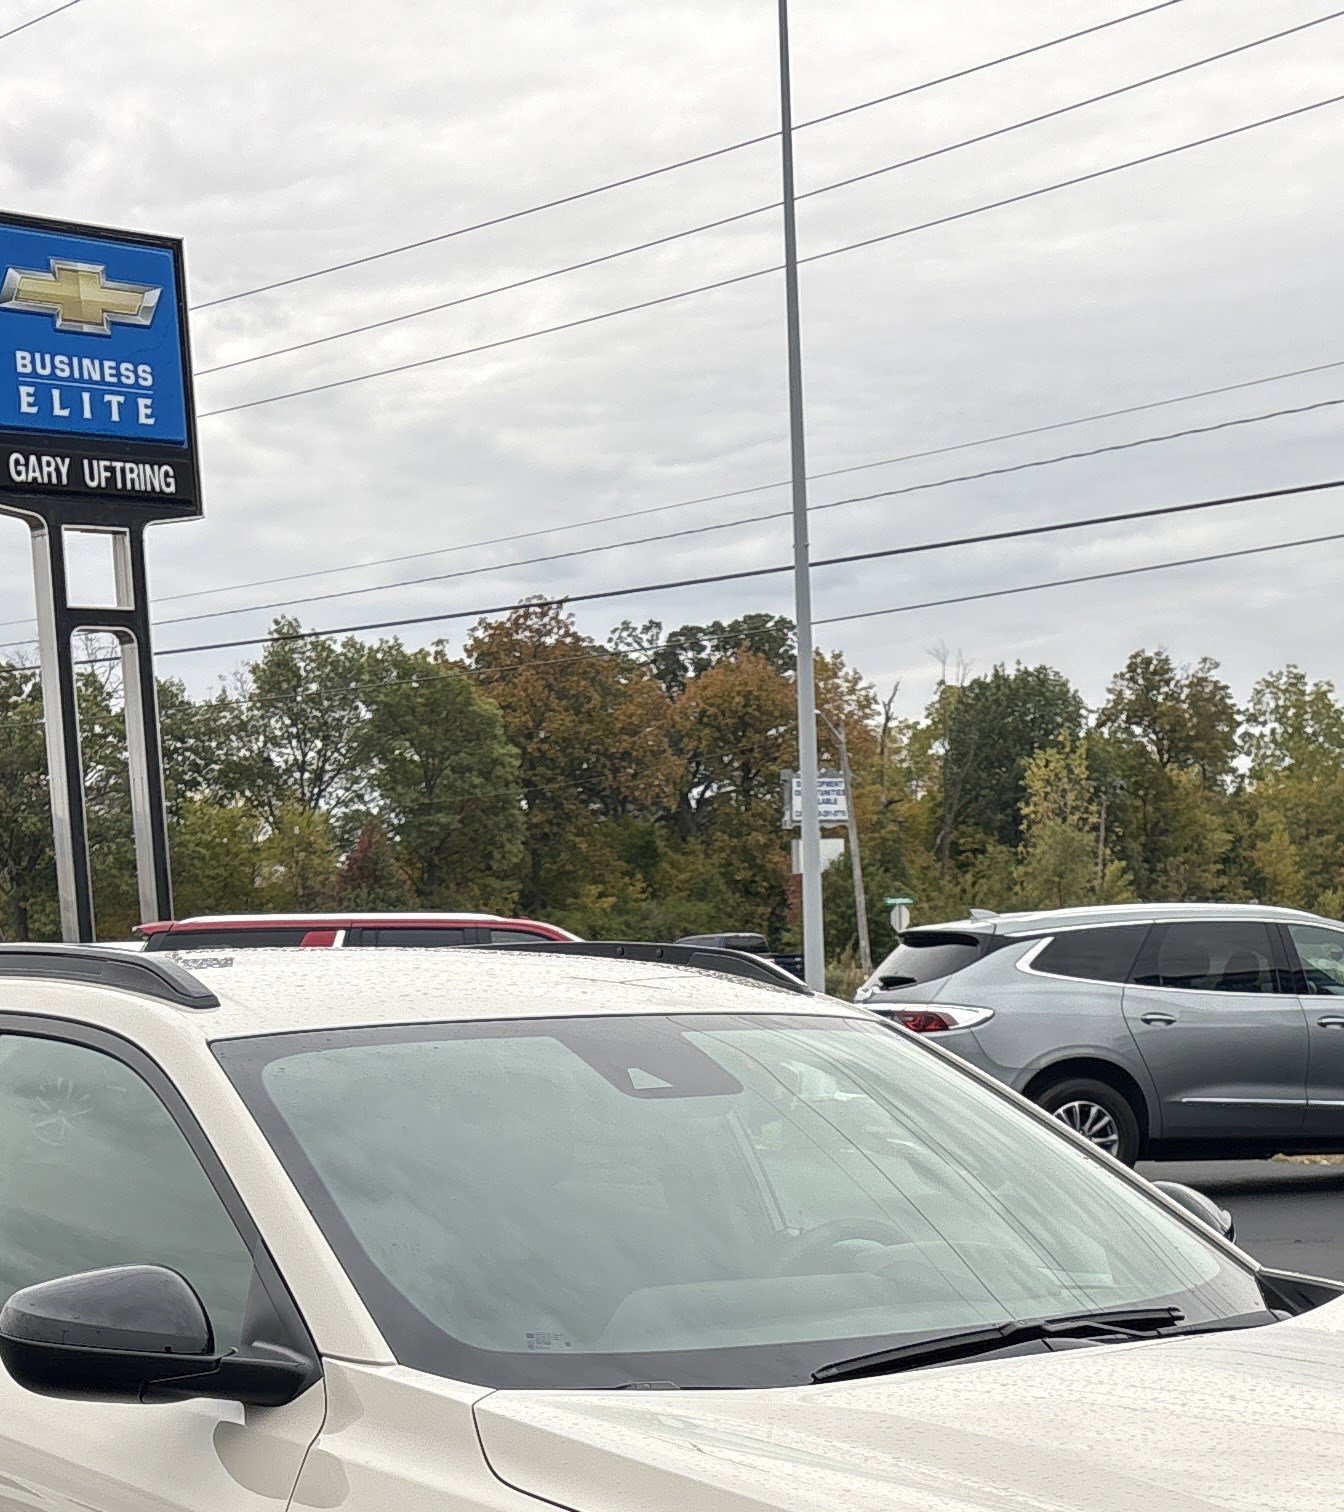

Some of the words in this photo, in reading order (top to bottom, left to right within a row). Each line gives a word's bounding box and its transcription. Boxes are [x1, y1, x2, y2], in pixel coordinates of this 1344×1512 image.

[15, 350, 153, 386] BUSINESS
[19, 387, 155, 424] ELITE
[9, 452, 71, 485] GARY
[83, 459, 176, 493] UFTRING
